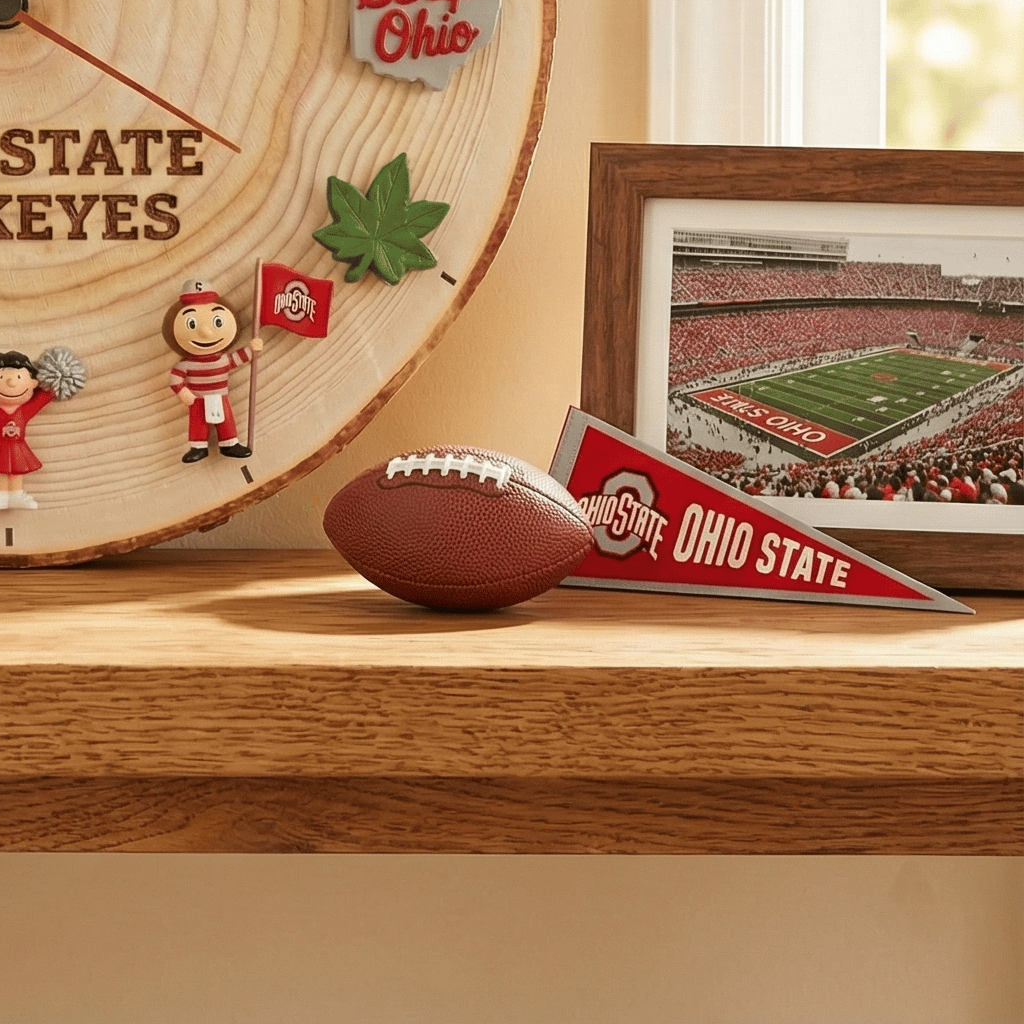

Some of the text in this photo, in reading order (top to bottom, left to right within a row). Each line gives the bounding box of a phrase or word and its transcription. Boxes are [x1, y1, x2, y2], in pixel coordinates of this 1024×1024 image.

[375, 8, 480, 63] Ohio
[673, 503, 852, 588] OHIO STATE
